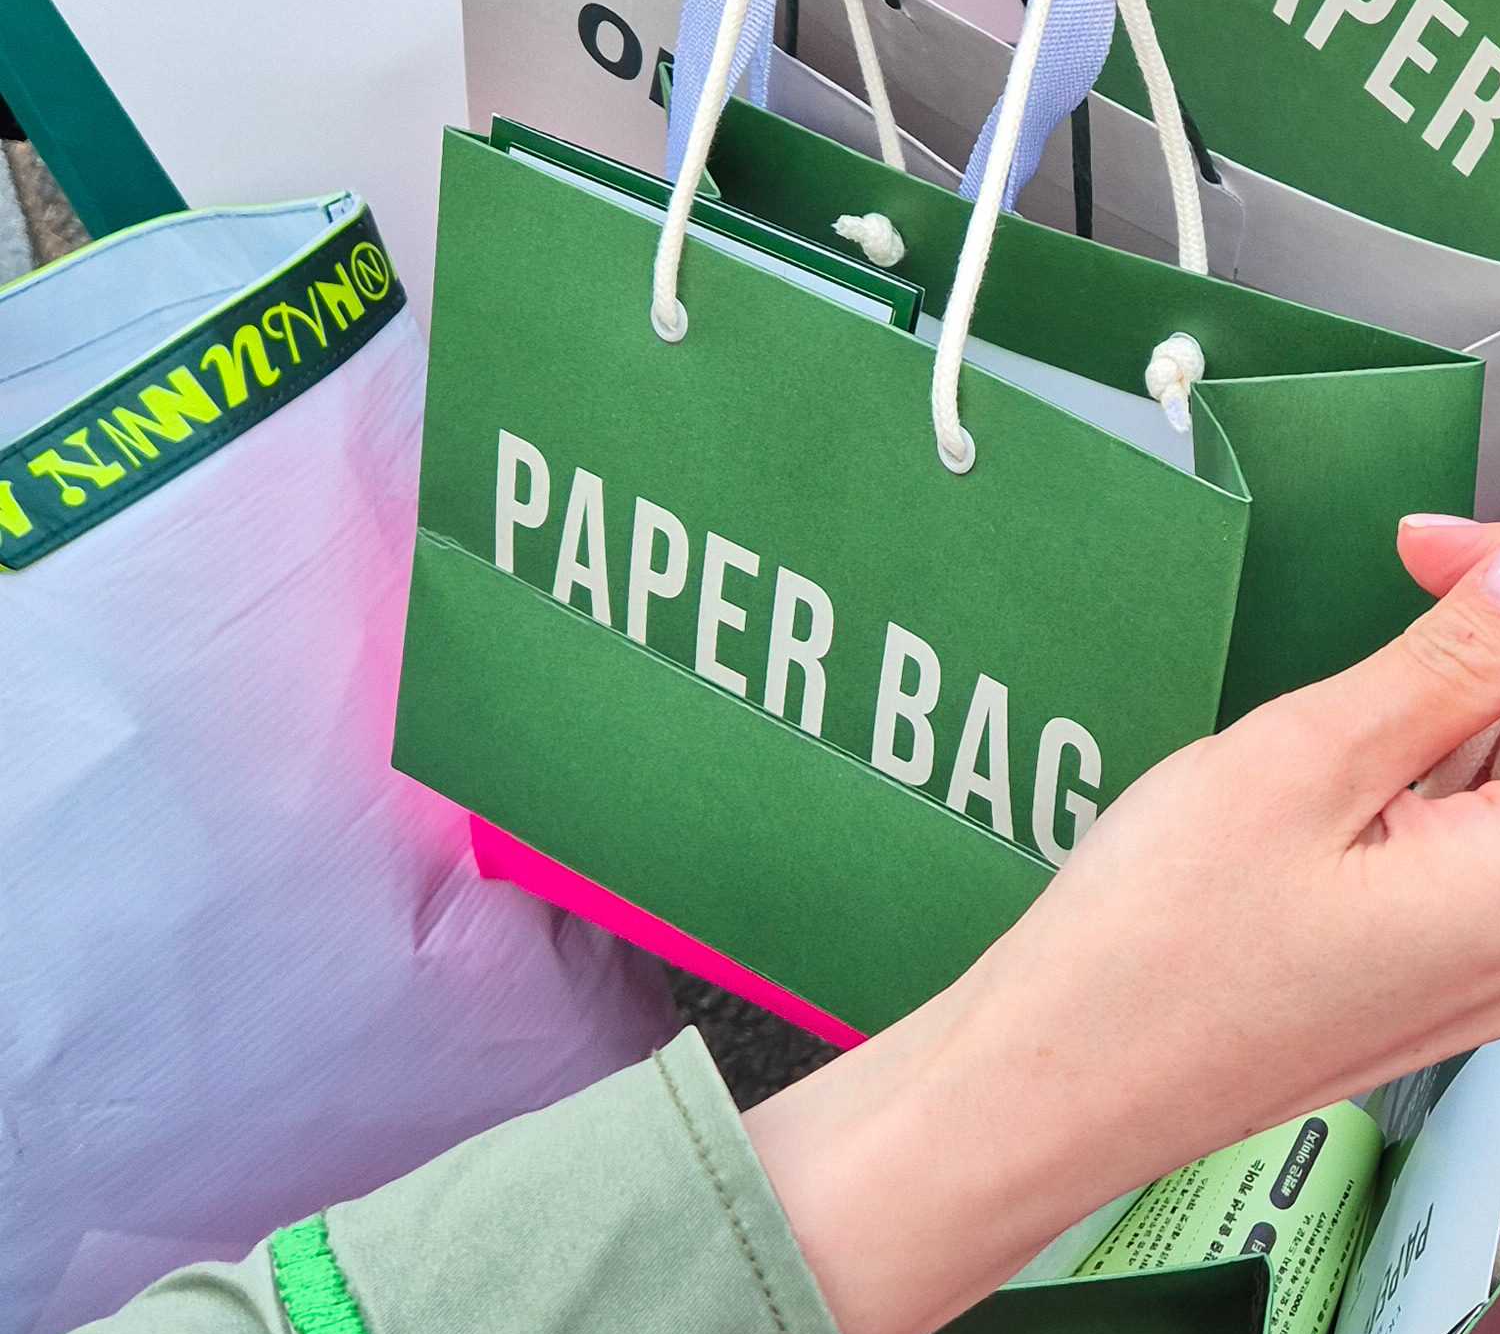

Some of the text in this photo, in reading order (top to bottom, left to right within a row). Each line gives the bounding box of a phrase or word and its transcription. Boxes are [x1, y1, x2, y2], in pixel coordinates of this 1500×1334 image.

[495, 428, 1102, 867] PAPER BAG
[1293, 1129, 1321, 1166] 이미지
[1215, 1195, 1247, 1239] 솔루션
[1236, 1156, 1266, 1198] 케어는
